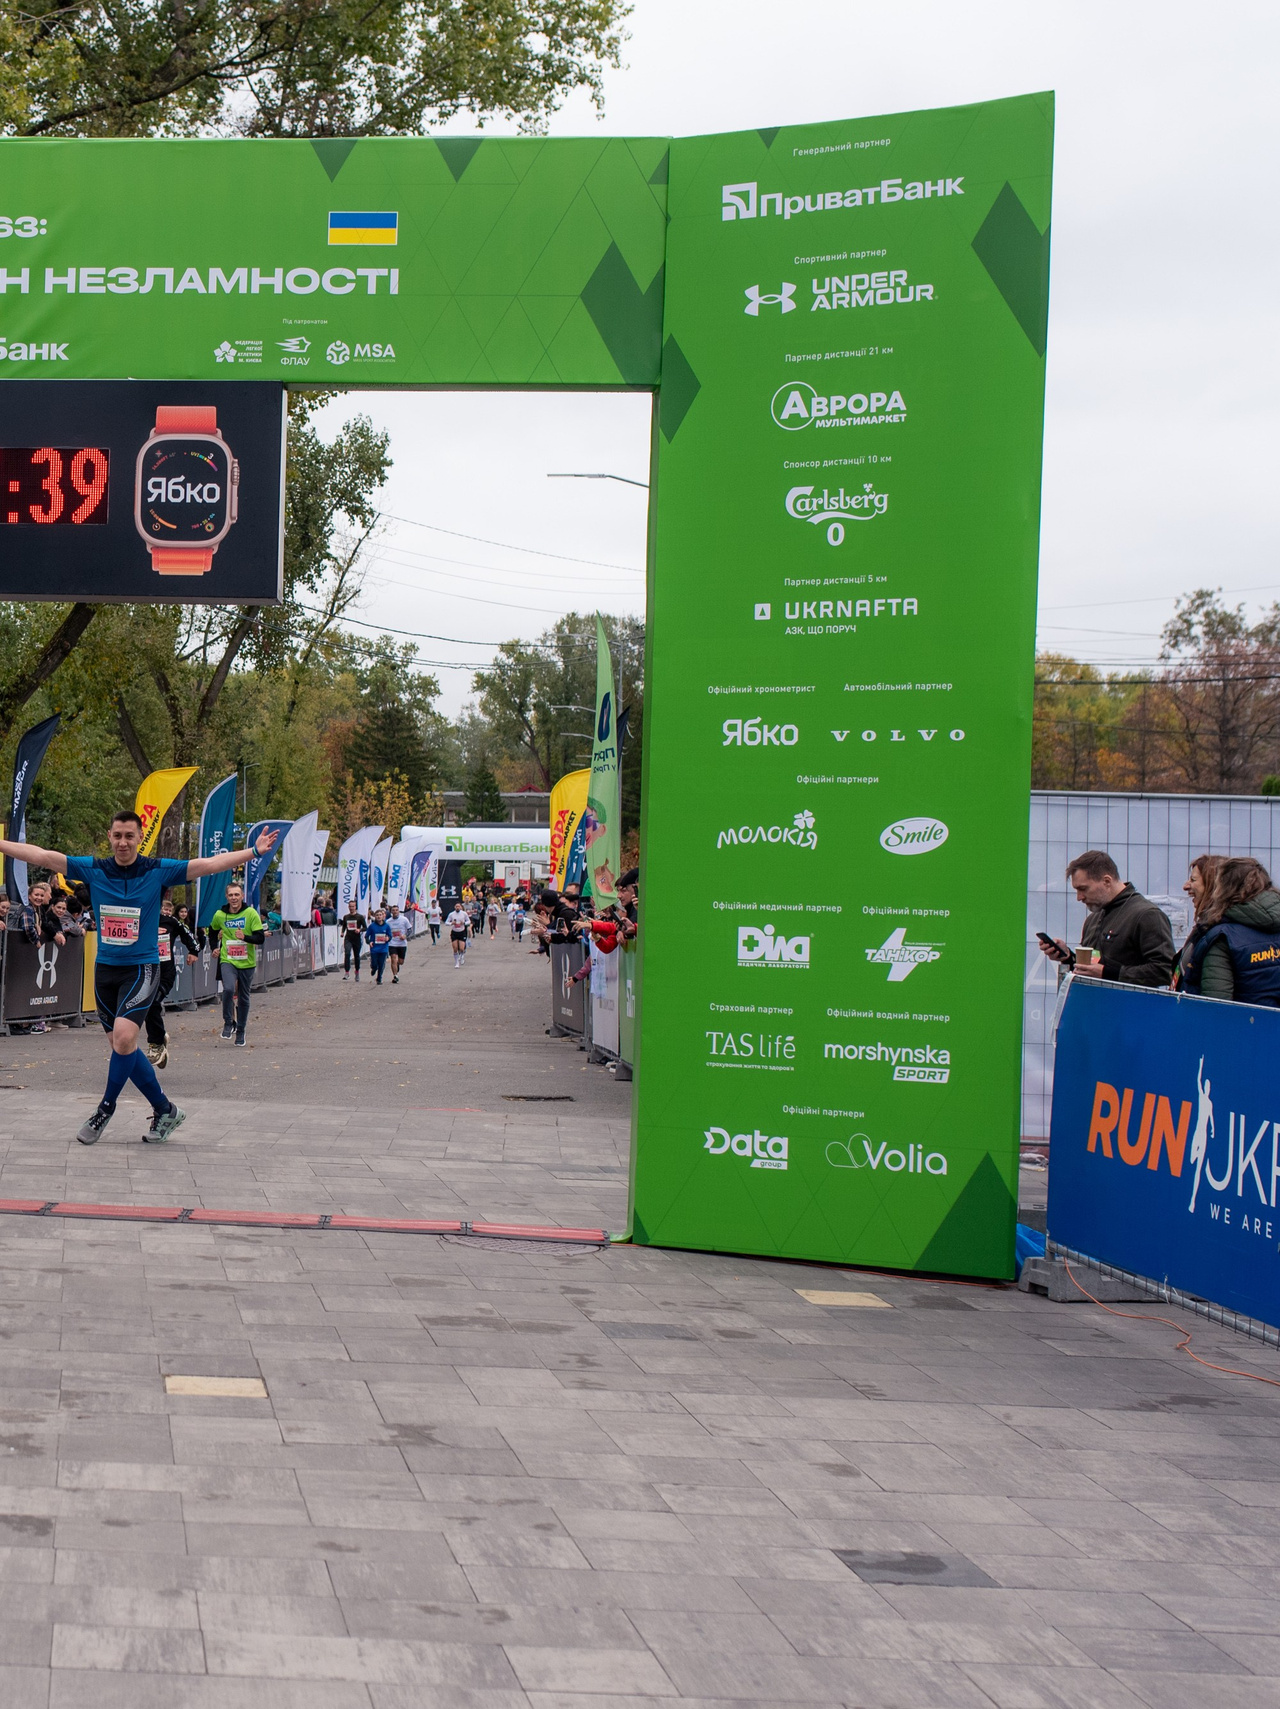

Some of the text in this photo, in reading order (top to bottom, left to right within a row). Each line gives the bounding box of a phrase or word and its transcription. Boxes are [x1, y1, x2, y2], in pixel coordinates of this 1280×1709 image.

[793, 139, 890, 156] Генеральний партнер
[761, 177, 964, 219] ПриватБанк
[794, 249, 886, 264] Спортивний партнер
[45, 267, 399, 294] НЕЗЛАМНОСТІ
[812, 270, 908, 294] UNDER
[810, 284, 934, 312] ARMOUR
[354, 344, 396, 358] MSA
[785, 351, 823, 363] Партнер
[824, 348, 866, 359] дистанції
[869, 347, 878, 355] 21
[281, 357, 310, 365] ФЛАУ
[815, 414, 907, 428] МУЛЬТИМАРКЕТ
[823, 456, 865, 467] дистанції
[868, 455, 877, 463] 10
[148, 475, 220, 503] Ябко
[785, 486, 889, 519] Carlsberg
[827, 522, 844, 546] 0
[785, 578, 821, 587] Партнер
[823, 575, 865, 585] дистанції
[786, 598, 917, 619] UKRNAFTA
[785, 625, 856, 635] АЗК, ЩО ПОРУЧ
[708, 686, 815, 695] Офіційний хронометрист
[844, 682, 952, 691] Автомобільний партнер
[723, 717, 798, 746] Ябко
[831, 729, 965, 741] VOLVO
[797, 775, 834, 784] Офіційні
[885, 822, 944, 847] Smile
[464, 842, 550, 854] ПриватБан
[713, 901, 757, 910] Офіційний
[806, 905, 842, 913] партнер
[863, 906, 950, 917] Офіційний партнер
[108, 927, 128, 938] 1605
[1251, 950, 1270, 962] RUN
[30, 996, 58, 1006] UNDER ARMOUR
[710, 1003, 793, 1015] Страховий партнер
[827, 1008, 873, 1018] Офіційний
[913, 1014, 950, 1023] партнер
[706, 1032, 753, 1056] TAS
[824, 1042, 950, 1065] morshynska
[706, 1062, 742, 1070] страхування
[896, 1068, 946, 1081] SPORT
[783, 1105, 864, 1119] Офіційні партнери
[1087, 1081, 1192, 1178] RUN
[704, 1126, 788, 1160] Data
[760, 1160, 782, 1169] group
[862, 1140, 947, 1175] Volia
[1210, 1202, 1272, 1239] WE ARE
